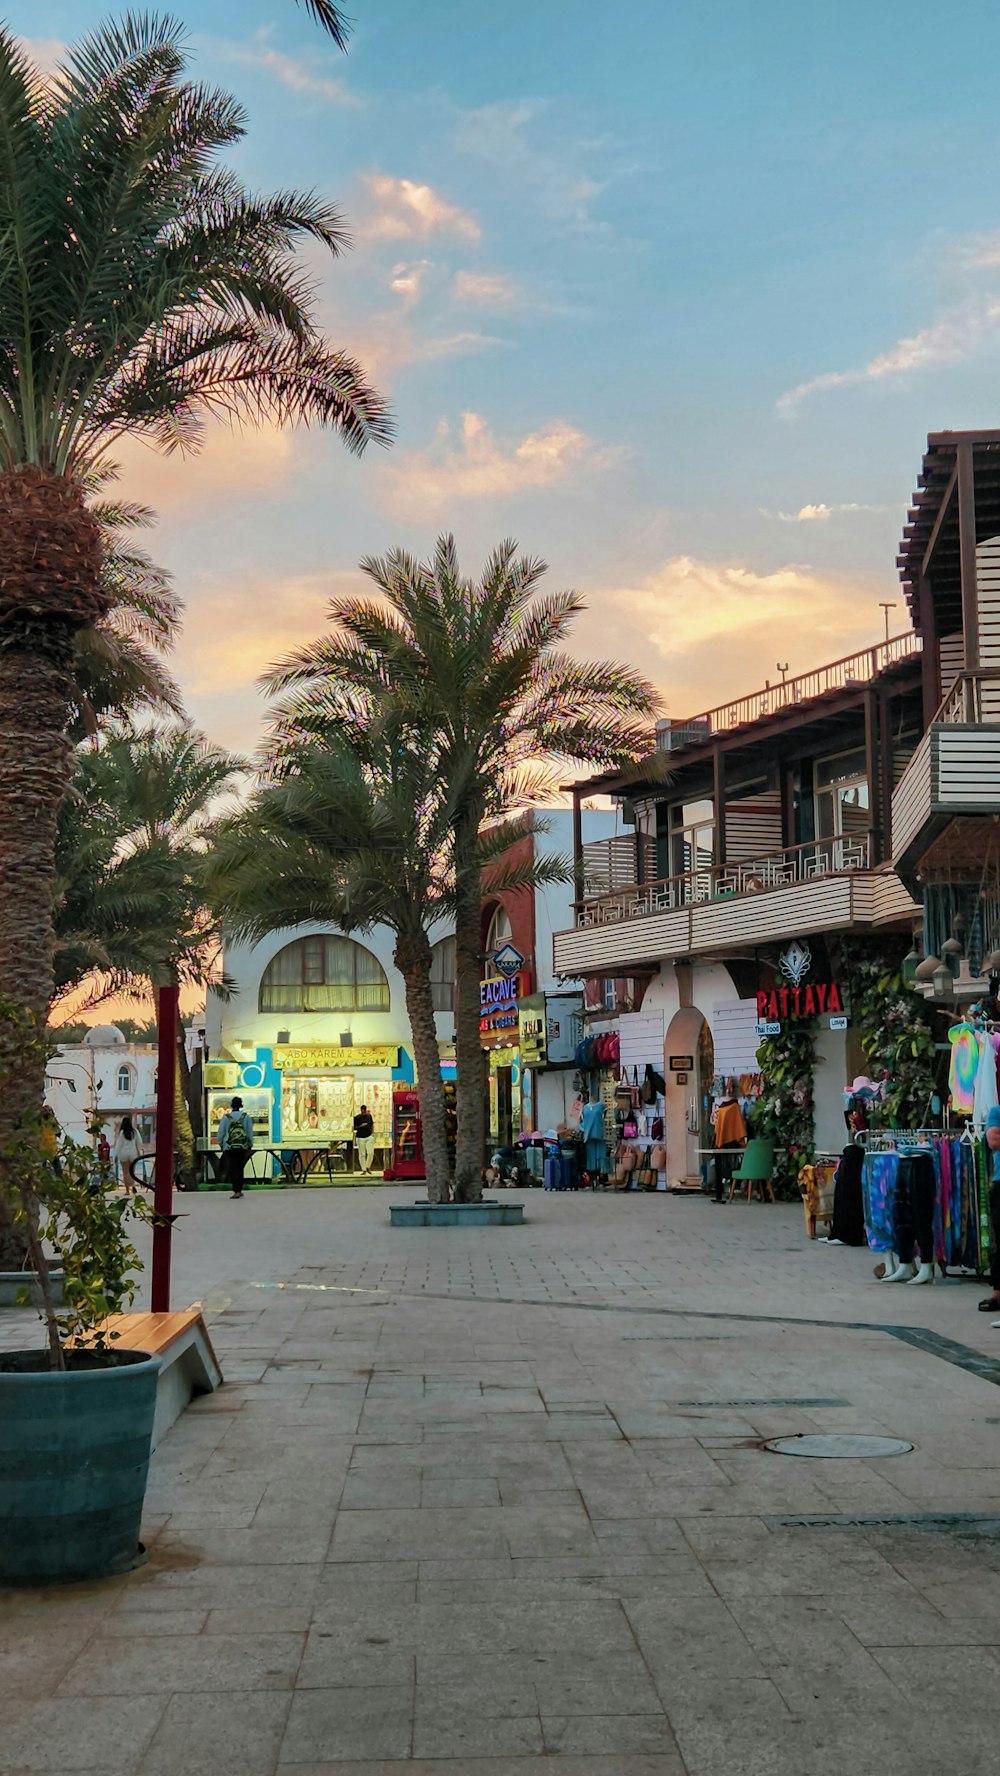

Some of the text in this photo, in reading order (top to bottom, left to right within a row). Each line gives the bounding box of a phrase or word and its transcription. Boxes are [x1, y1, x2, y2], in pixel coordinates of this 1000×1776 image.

[480, 977, 517, 1004] EACAVE
[757, 983, 842, 1018] PATTAYA
[755, 1023, 779, 1034] Thai Food
[287, 1049, 308, 1059] ABO
[310, 1049, 345, 1059] KAREM
